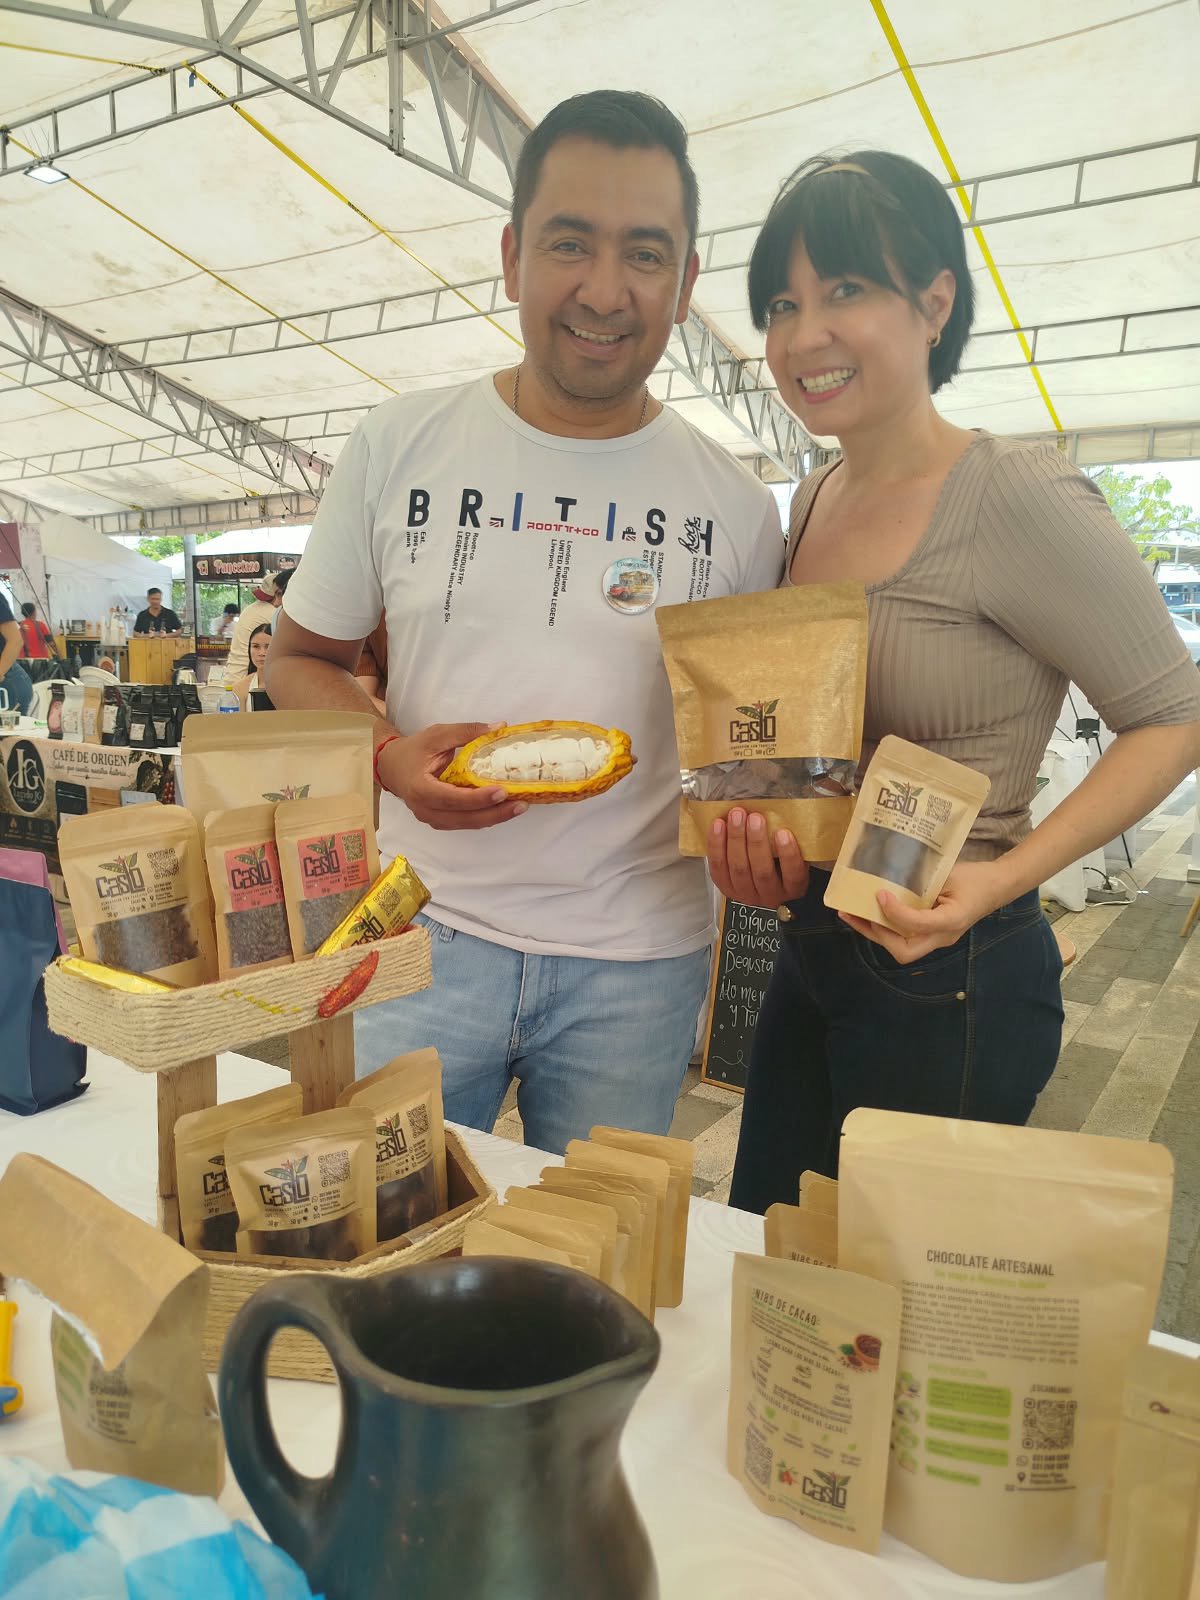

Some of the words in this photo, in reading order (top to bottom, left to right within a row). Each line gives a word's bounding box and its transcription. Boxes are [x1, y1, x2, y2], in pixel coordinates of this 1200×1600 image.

[452, 530, 461, 571] LEGENDARY
[463, 532, 471, 552] Denim
[557, 540, 565, 564] UNITED
[563, 540, 573, 564] London
[457, 552, 468, 586] INDUSTRY
[553, 565, 562, 598] KINGDOM
[561, 566, 570, 592] England
[444, 589, 453, 612] Ninety
[549, 598, 557, 627] LEGEND
[53, 747, 75, 762] CAFÉ
[77, 751, 89, 764] DE
[91, 752, 127, 767] ORIGEN
[926, 1249, 989, 1270] CHOCOLATE
[992, 1257, 1054, 1277] ARTESANAL
[776, 1298, 787, 1312] DE
